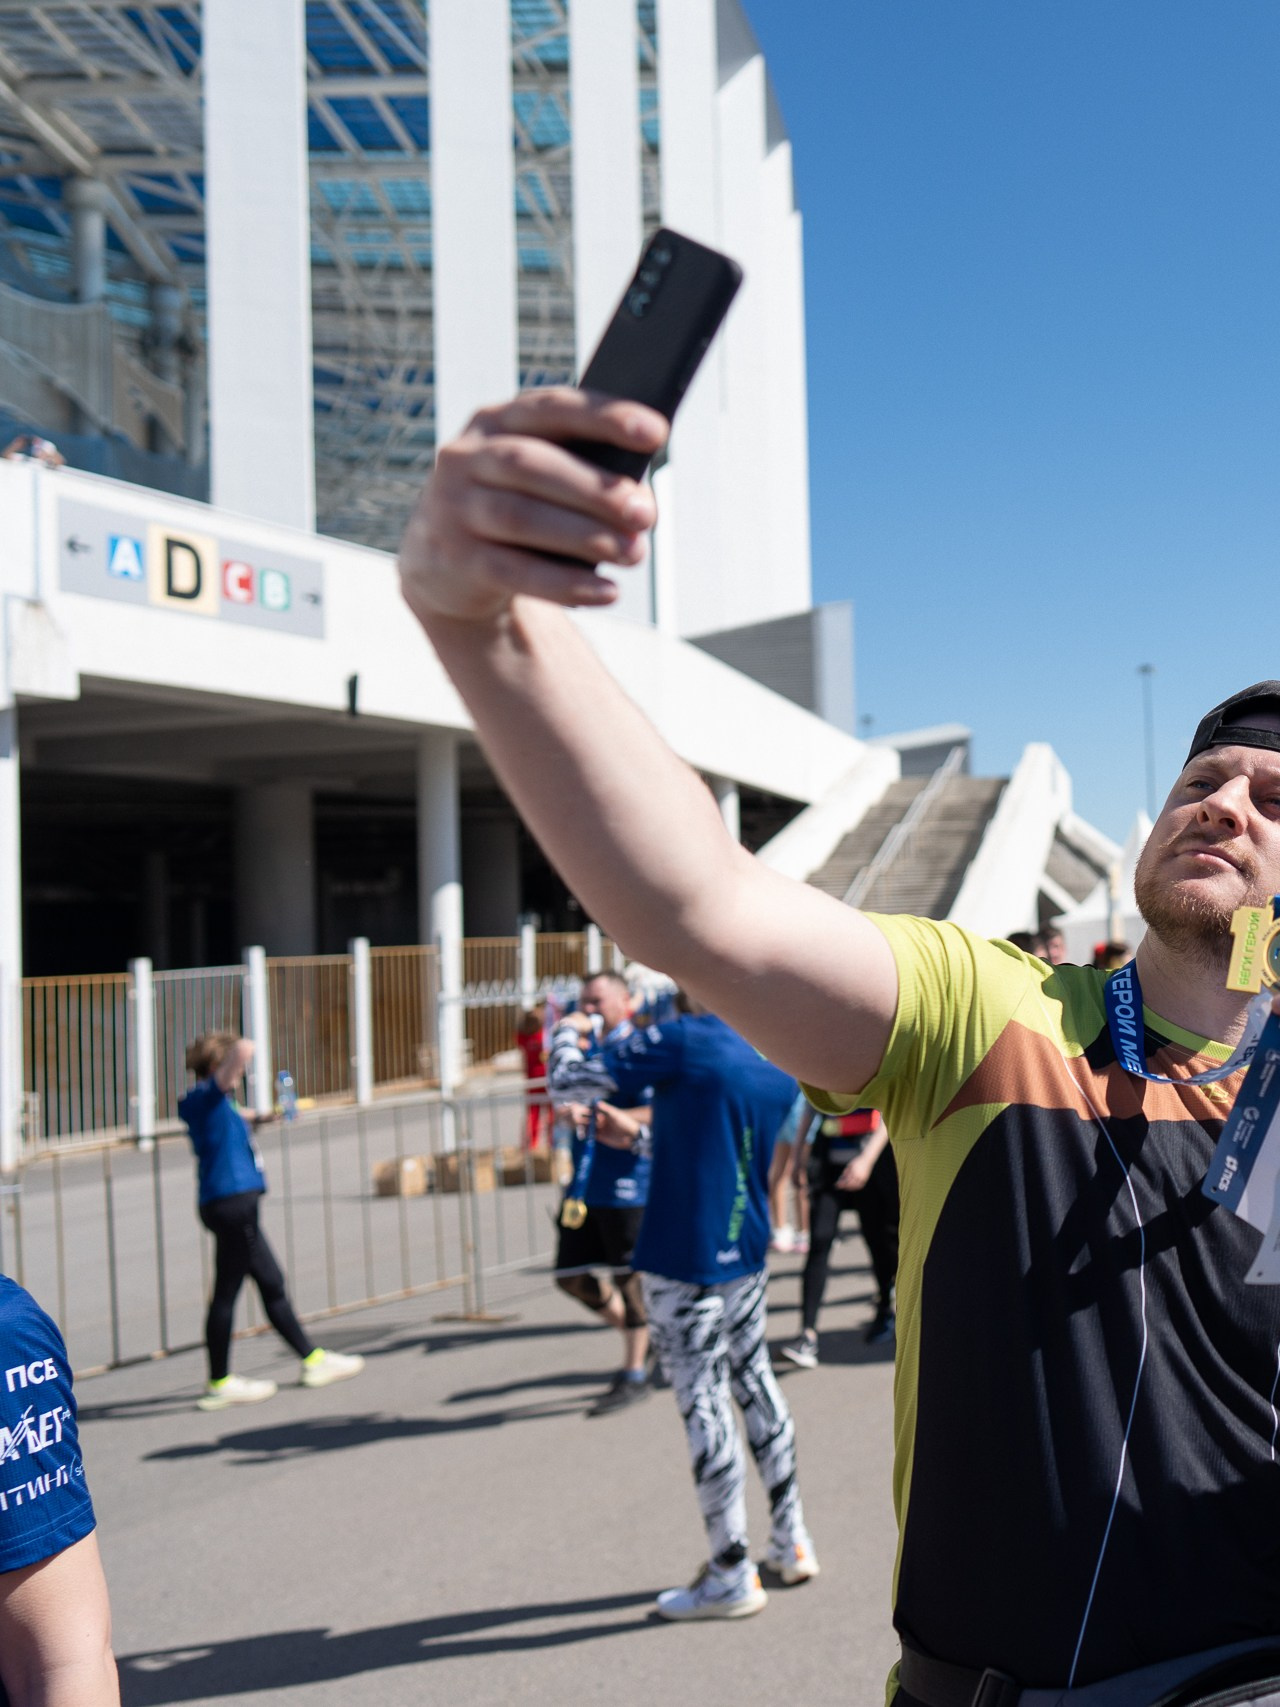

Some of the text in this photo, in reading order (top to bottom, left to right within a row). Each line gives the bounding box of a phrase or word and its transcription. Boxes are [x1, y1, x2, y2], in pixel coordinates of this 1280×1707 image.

[111, 537, 289, 608] A D C B
[1239, 957, 1252, 985] БЕГИ
[1111, 967, 1136, 1037] ГЕРОИ
[5, 1357, 58, 1393] ПСБ
